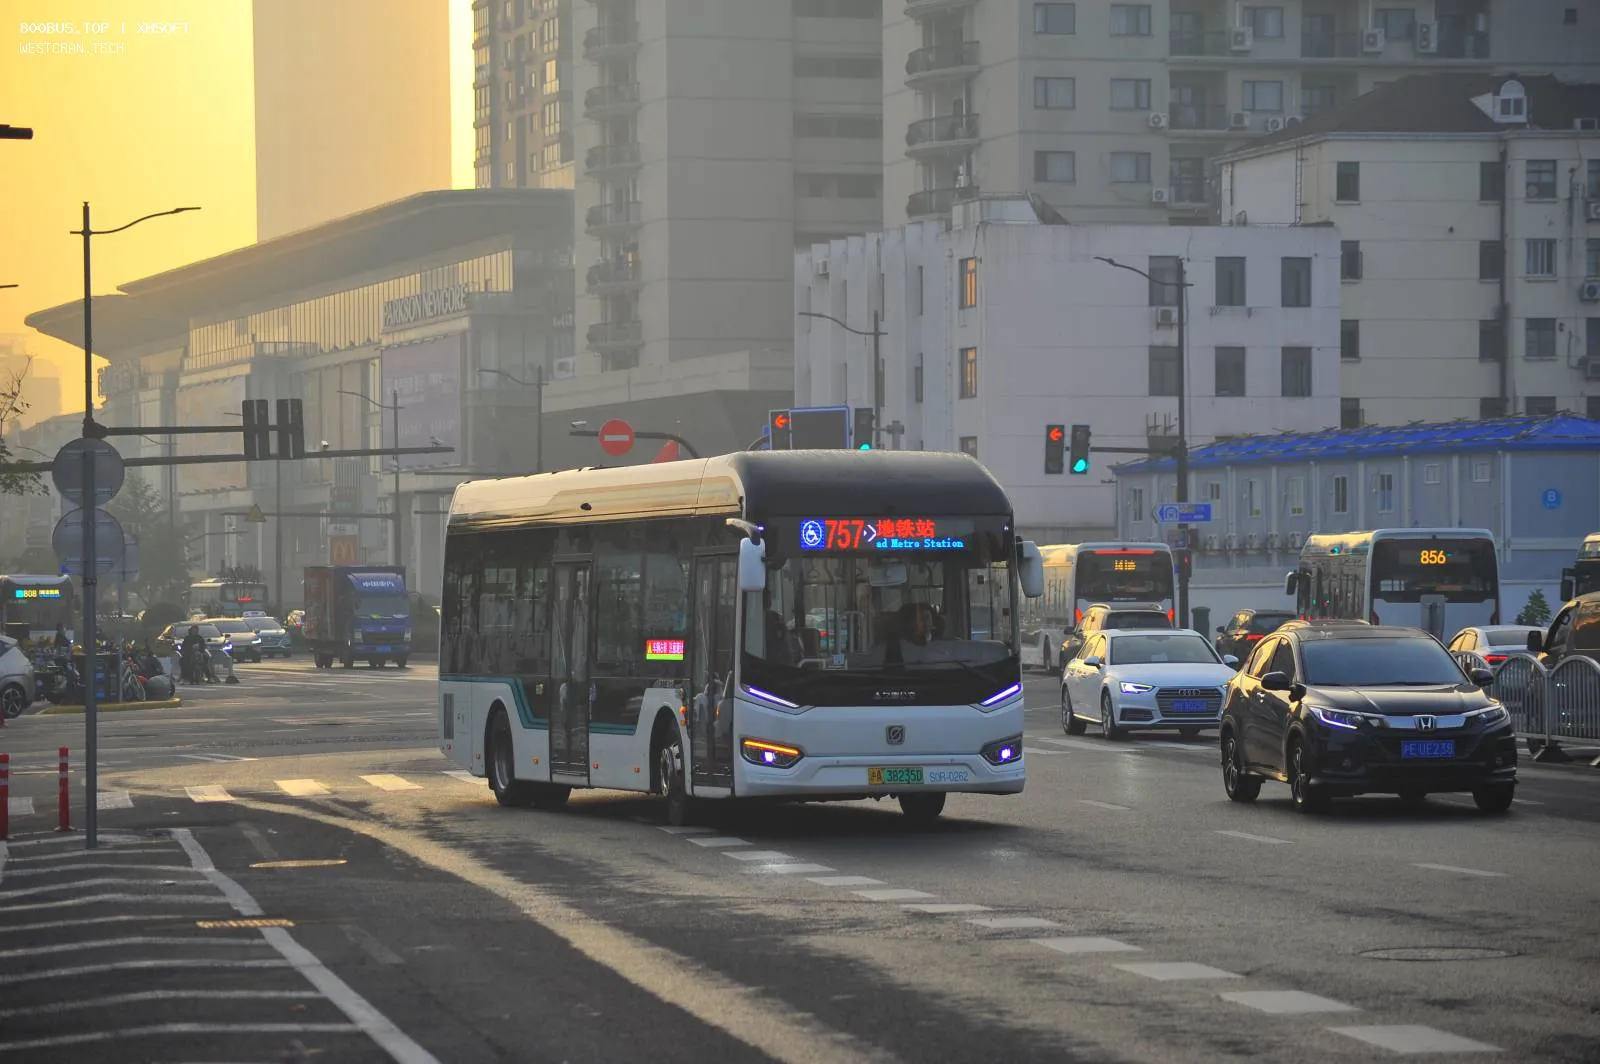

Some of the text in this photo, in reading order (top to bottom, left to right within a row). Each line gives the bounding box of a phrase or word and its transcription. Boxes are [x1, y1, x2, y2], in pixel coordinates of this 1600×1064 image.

[383, 284, 466, 327] PARKSON NEWCORE
[825, 518, 936, 549] 757 地铁站
[876, 538, 965, 548] ad Metro Station
[1421, 550, 1446, 564] 856
